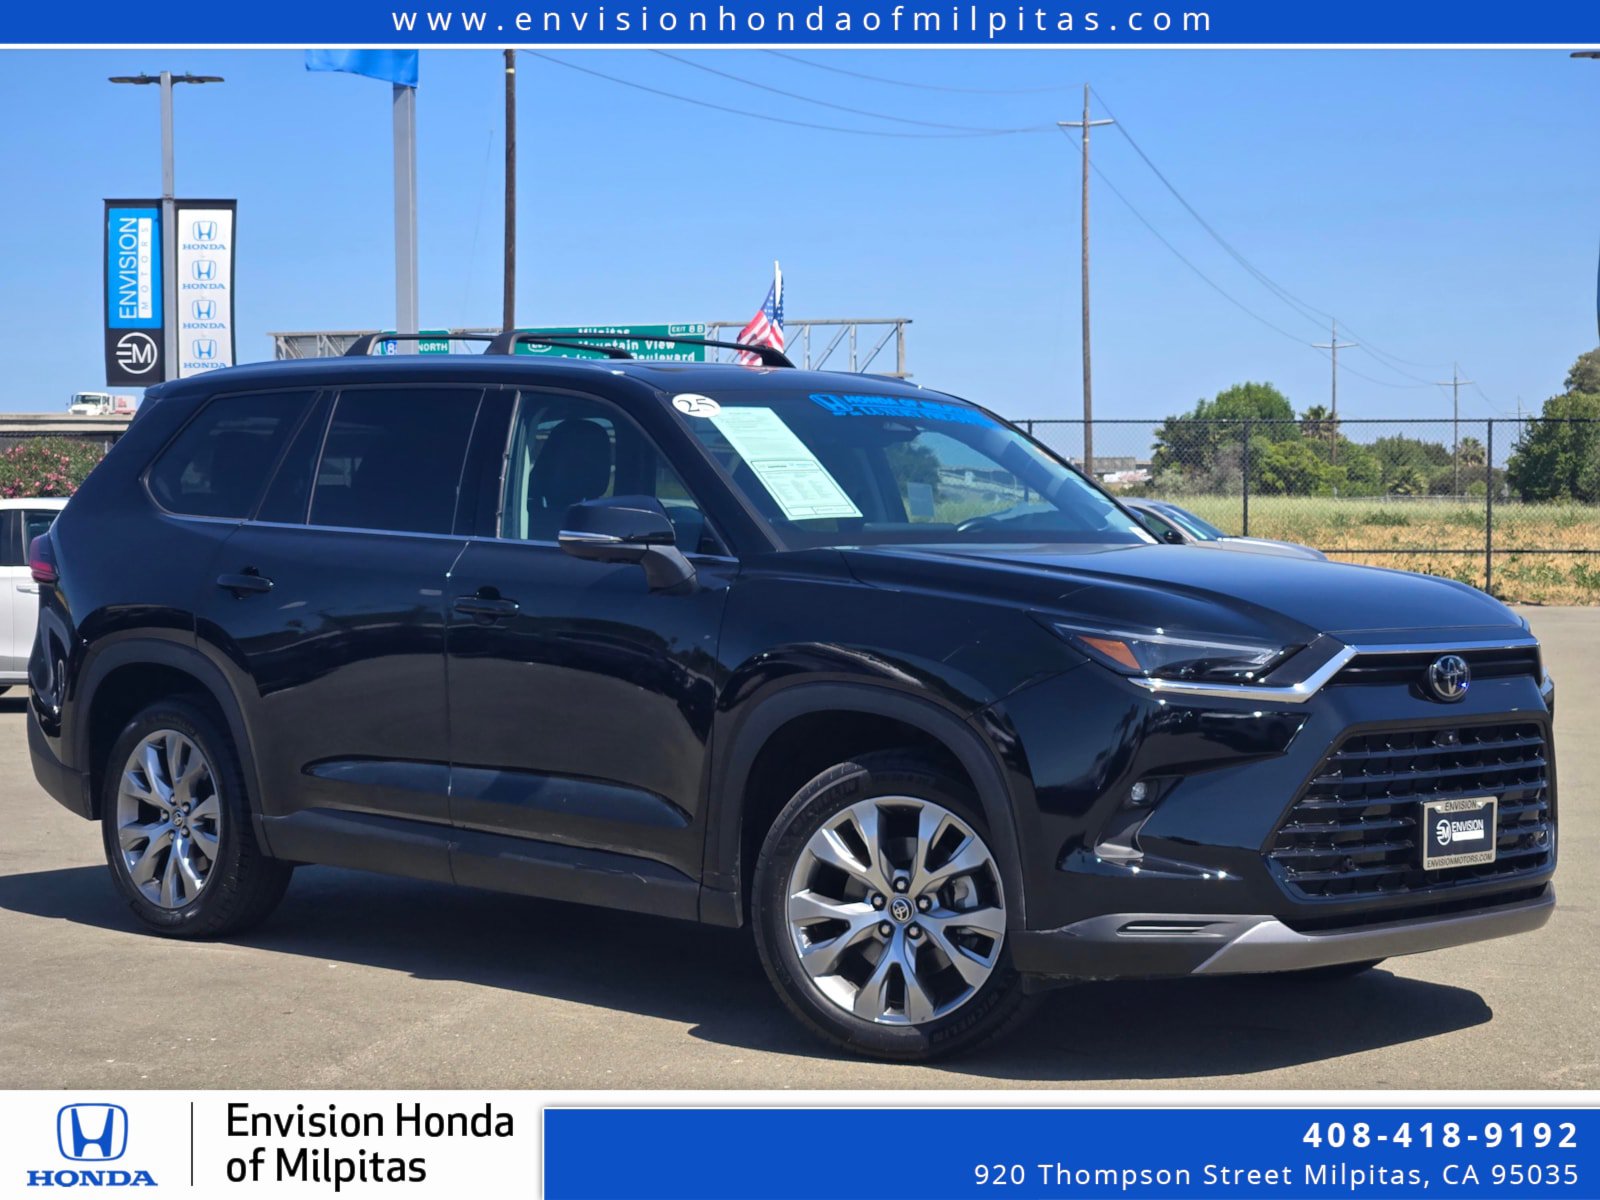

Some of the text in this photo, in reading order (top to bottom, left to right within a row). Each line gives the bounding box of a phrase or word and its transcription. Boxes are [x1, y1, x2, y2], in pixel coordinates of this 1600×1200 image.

[119, 217, 138, 319] ENVISION
[141, 227, 149, 310] MOTORS
[645, 339, 676, 350] View
[677, 398, 716, 413] 25
[1444, 800, 1477, 811] ENVISION
[1451, 819, 1484, 833] ENVISION
[1426, 853, 1493, 868] ENVISIONMOTORS.COM
